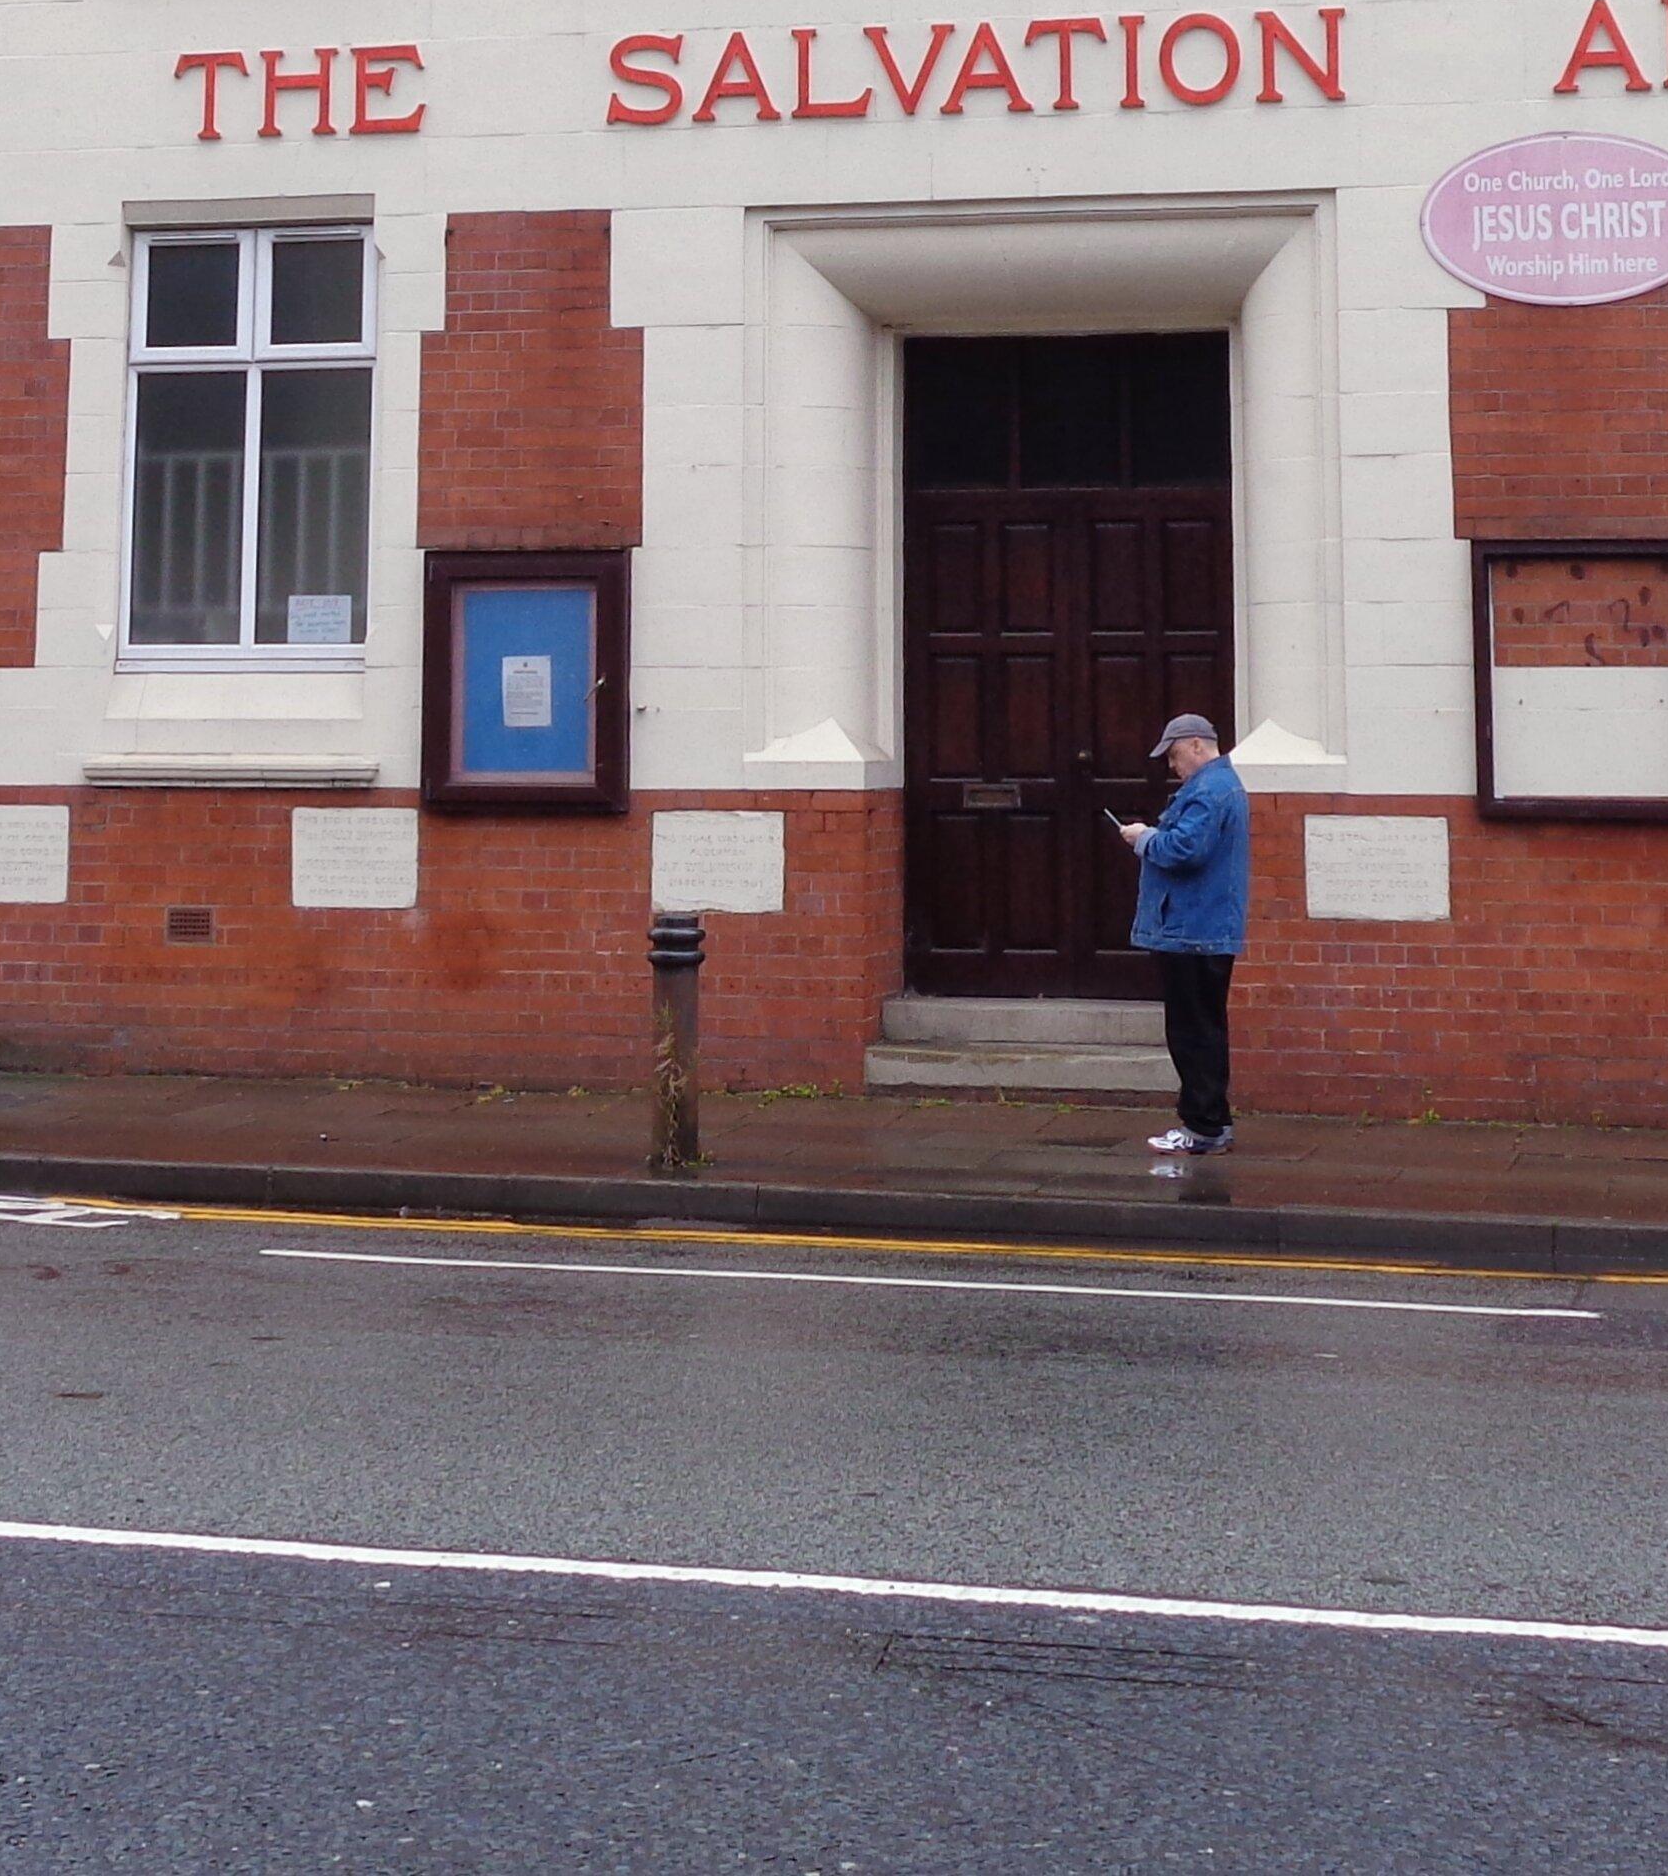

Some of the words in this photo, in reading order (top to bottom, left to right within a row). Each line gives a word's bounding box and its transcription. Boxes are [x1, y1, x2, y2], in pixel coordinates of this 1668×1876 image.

[175, 45, 426, 139] THE
[606, 9, 1345, 124] SALVATION
[1464, 173, 1502, 193] One
[1507, 170, 1579, 194] Church,
[1583, 168, 1625, 188] One
[1472, 204, 1554, 251] JESUS
[1560, 200, 1667, 238] CHRIST
[1486, 255, 1564, 281] Worship
[1568, 253, 1609, 274] Him
[1613, 253, 1658, 273] here
